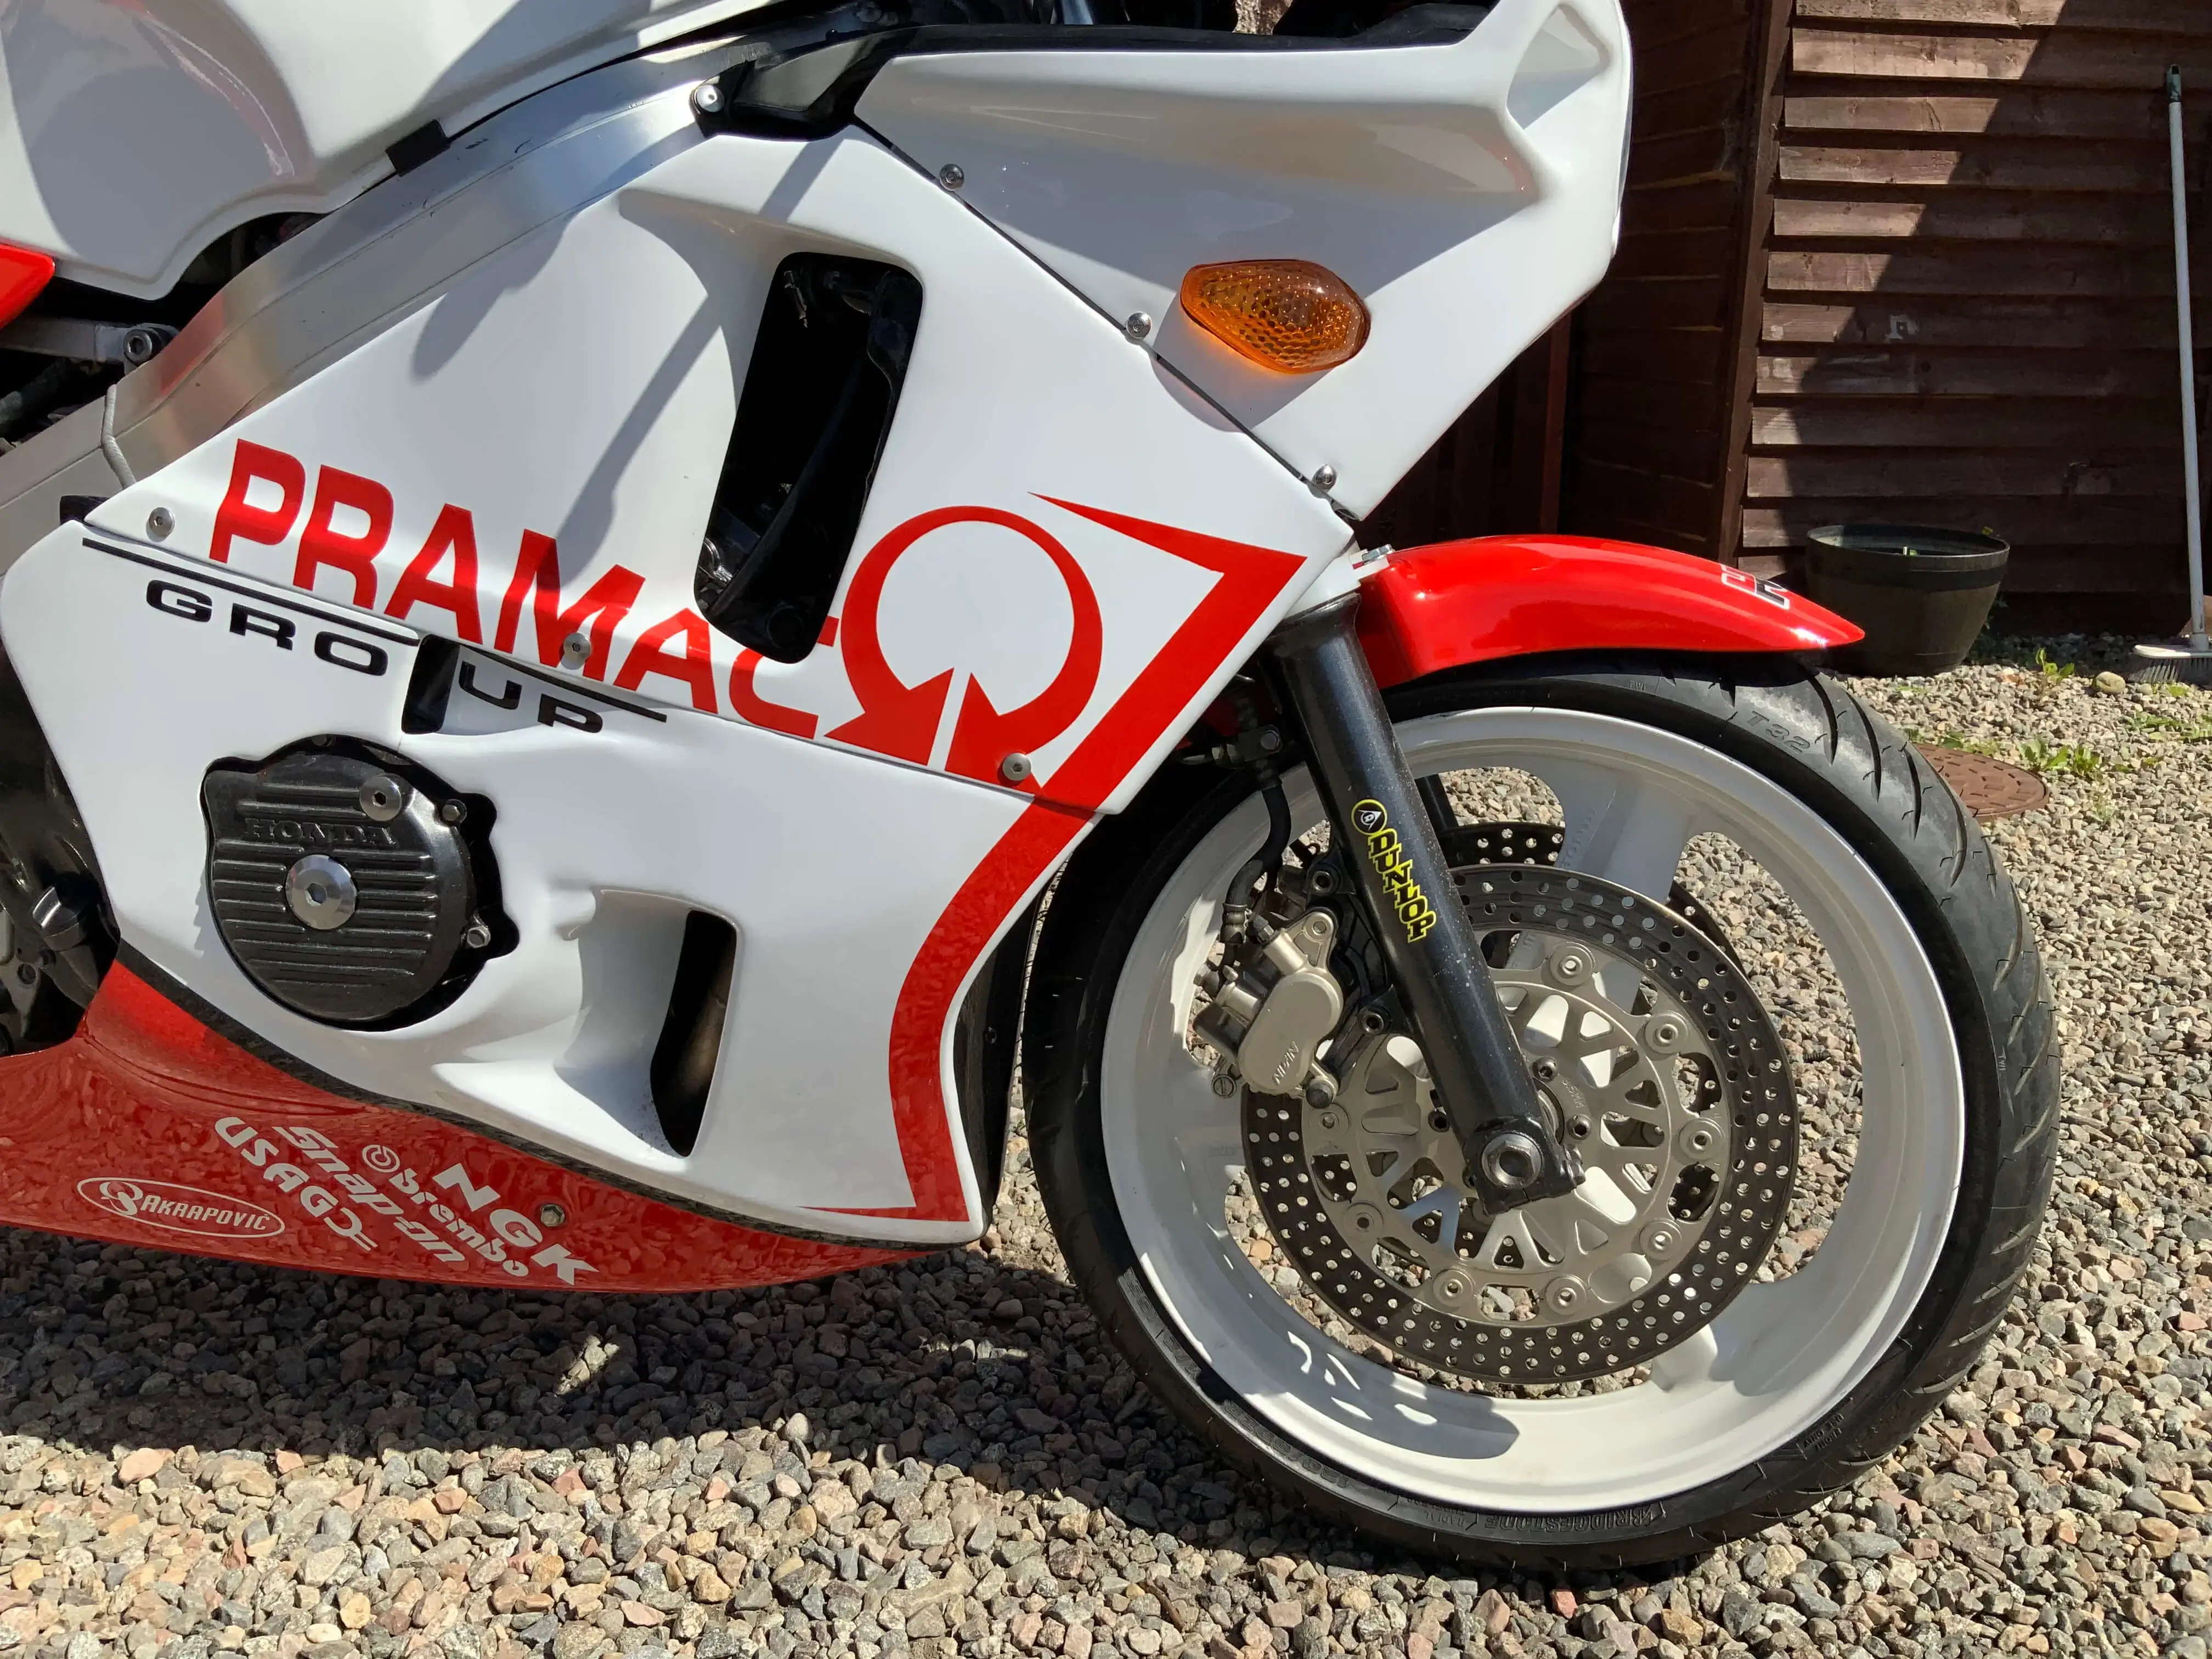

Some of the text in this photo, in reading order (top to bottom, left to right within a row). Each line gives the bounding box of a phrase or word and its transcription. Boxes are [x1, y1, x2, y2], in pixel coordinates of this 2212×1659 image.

[209, 438, 839, 740] PRAMAC
[146, 579, 603, 733] GROUP
[1747, 710, 1810, 754] T32
[245, 818, 397, 845] HONDA
[1367, 827, 1437, 943] DUNLOP
[1272, 1041, 1299, 1085] NISSIN
[215, 1117, 339, 1217] USAG
[272, 1126, 466, 1262] Snap-on
[388, 1168, 528, 1277] brembo
[432, 1163, 600, 1285] NGK
[1485, 1508, 1652, 1533] BRIDGESTONE
